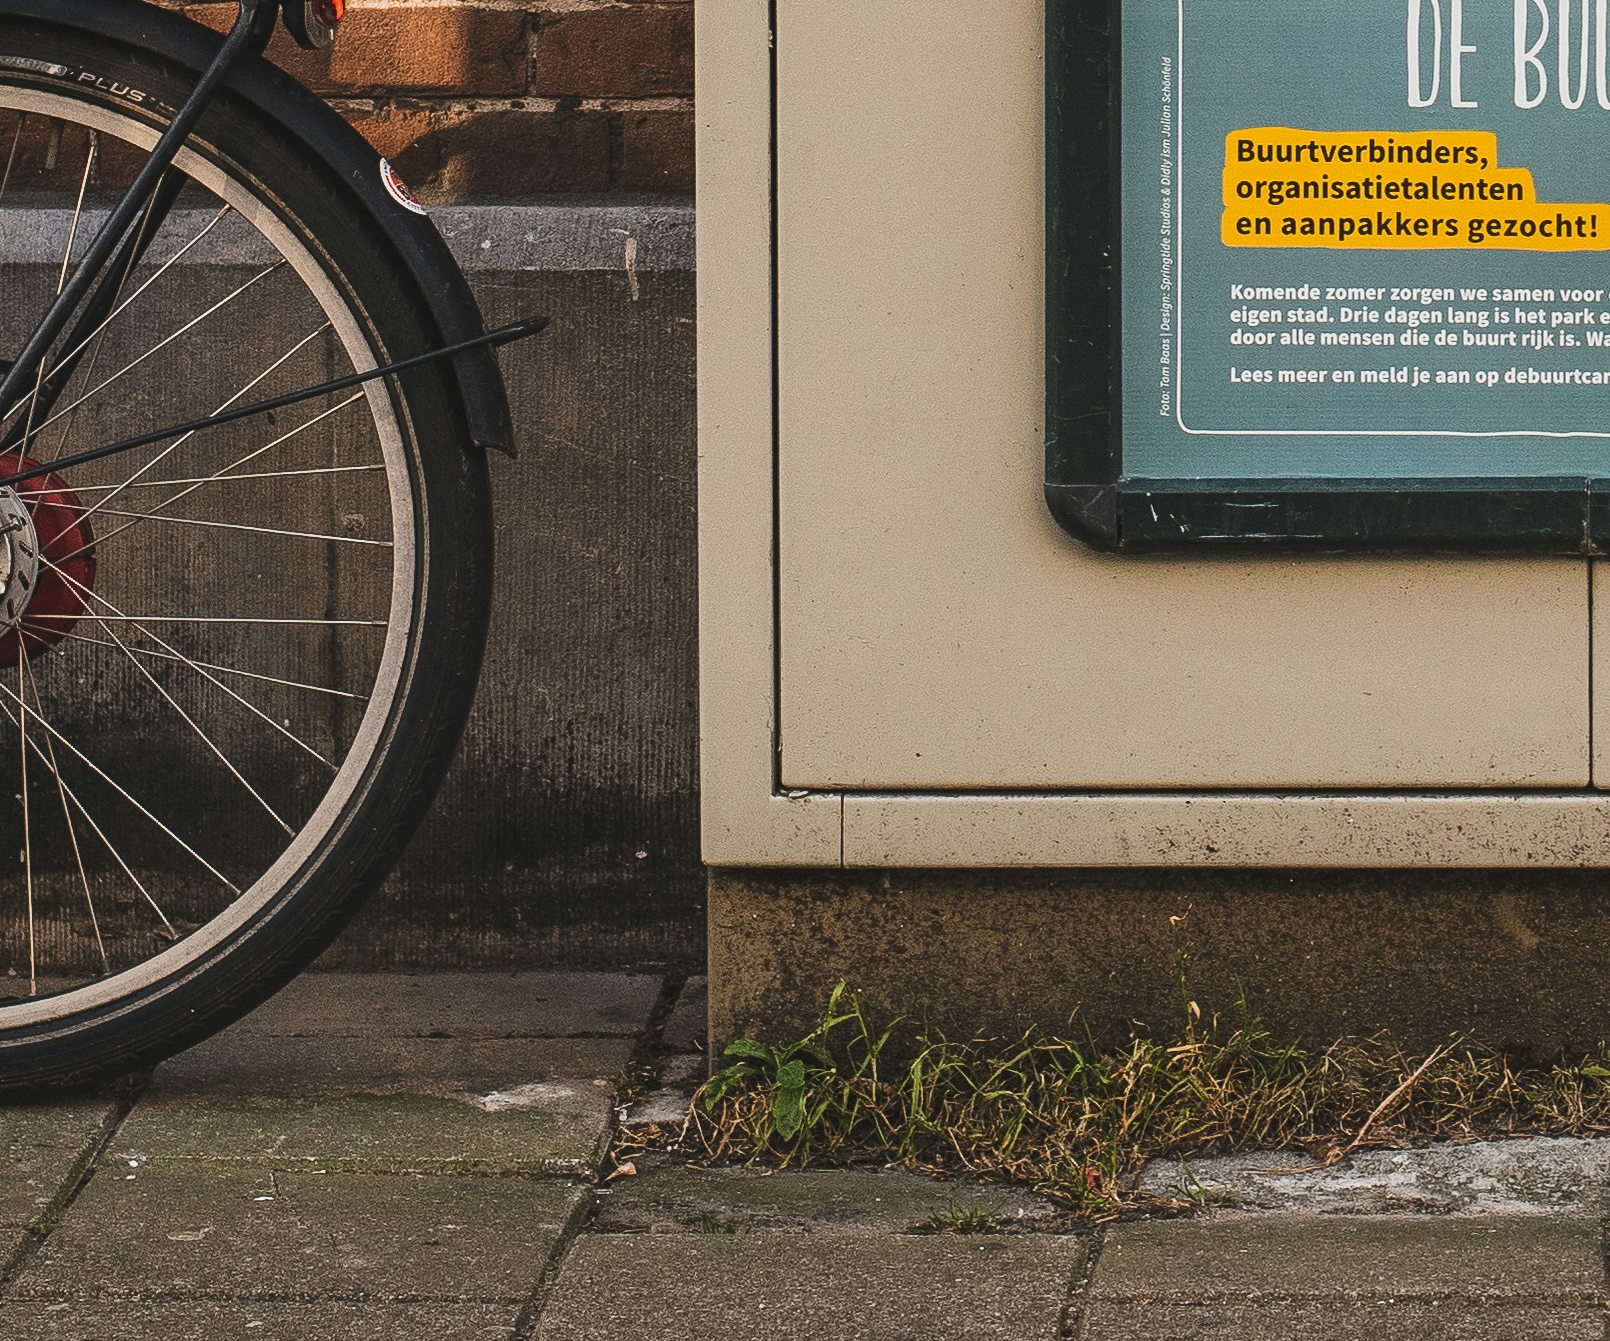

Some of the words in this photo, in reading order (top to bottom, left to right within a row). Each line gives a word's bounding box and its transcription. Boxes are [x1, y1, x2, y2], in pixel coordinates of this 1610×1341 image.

[77, 72, 147, 102] PLUS
[1162, 57, 1171, 103] Schönfeld
[1161, 106, 1171, 137] Julian
[1161, 139, 1171, 157] ism
[1236, 139, 1489, 170] Buurtverbinders,
[1161, 158, 1173, 186] Didly
[1161, 187, 1171, 196] &
[1236, 175, 1524, 206] organisatietalenten
[1161, 197, 1171, 235] Studios
[1236, 216, 1272, 236] en
[1281, 212, 1458, 241] aanpakkers
[1468, 214, 1598, 244] gezocht!
[1161, 236, 1173, 290] Springtide
[1230, 284, 1320, 301] Komende
[1325, 287, 1386, 301] zomer
[1390, 287, 1455, 305] zorgen
[1459, 288, 1488, 301] we
[1492, 288, 1555, 302] samen
[1560, 289, 1603, 302] voor
[1161, 293, 1172, 331] Design:
[1230, 306, 1282, 327] eigen
[1287, 307, 1334, 323] stad.
[1340, 307, 1380, 323] Drie
[1384, 307, 1443, 327] dagen
[1448, 307, 1489, 328] lang
[1494, 308, 1510, 324] is
[1515, 308, 1546, 324] het
[1551, 308, 1594, 329] park
[1160, 338, 1170, 365] Baas
[1230, 329, 1275, 345] door
[1280, 329, 1315, 345] alle
[1321, 332, 1394, 346] mensen
[1400, 330, 1430, 346] die
[1435, 330, 1458, 346] de
[1463, 330, 1516, 346] buurt
[1521, 330, 1554, 350] rijk
[1559, 331, 1581, 347] is.
[1160, 366, 1170, 388] Tom
[1230, 367, 1273, 383] Lees
[1279, 370, 1327, 383] meer
[1332, 370, 1355, 383] en
[1361, 367, 1408, 384] meld
[1411, 367, 1430, 386] je
[1435, 371, 1469, 383] aan
[1475, 370, 1499, 387] op
[1160, 390, 1170, 416] Foto:
